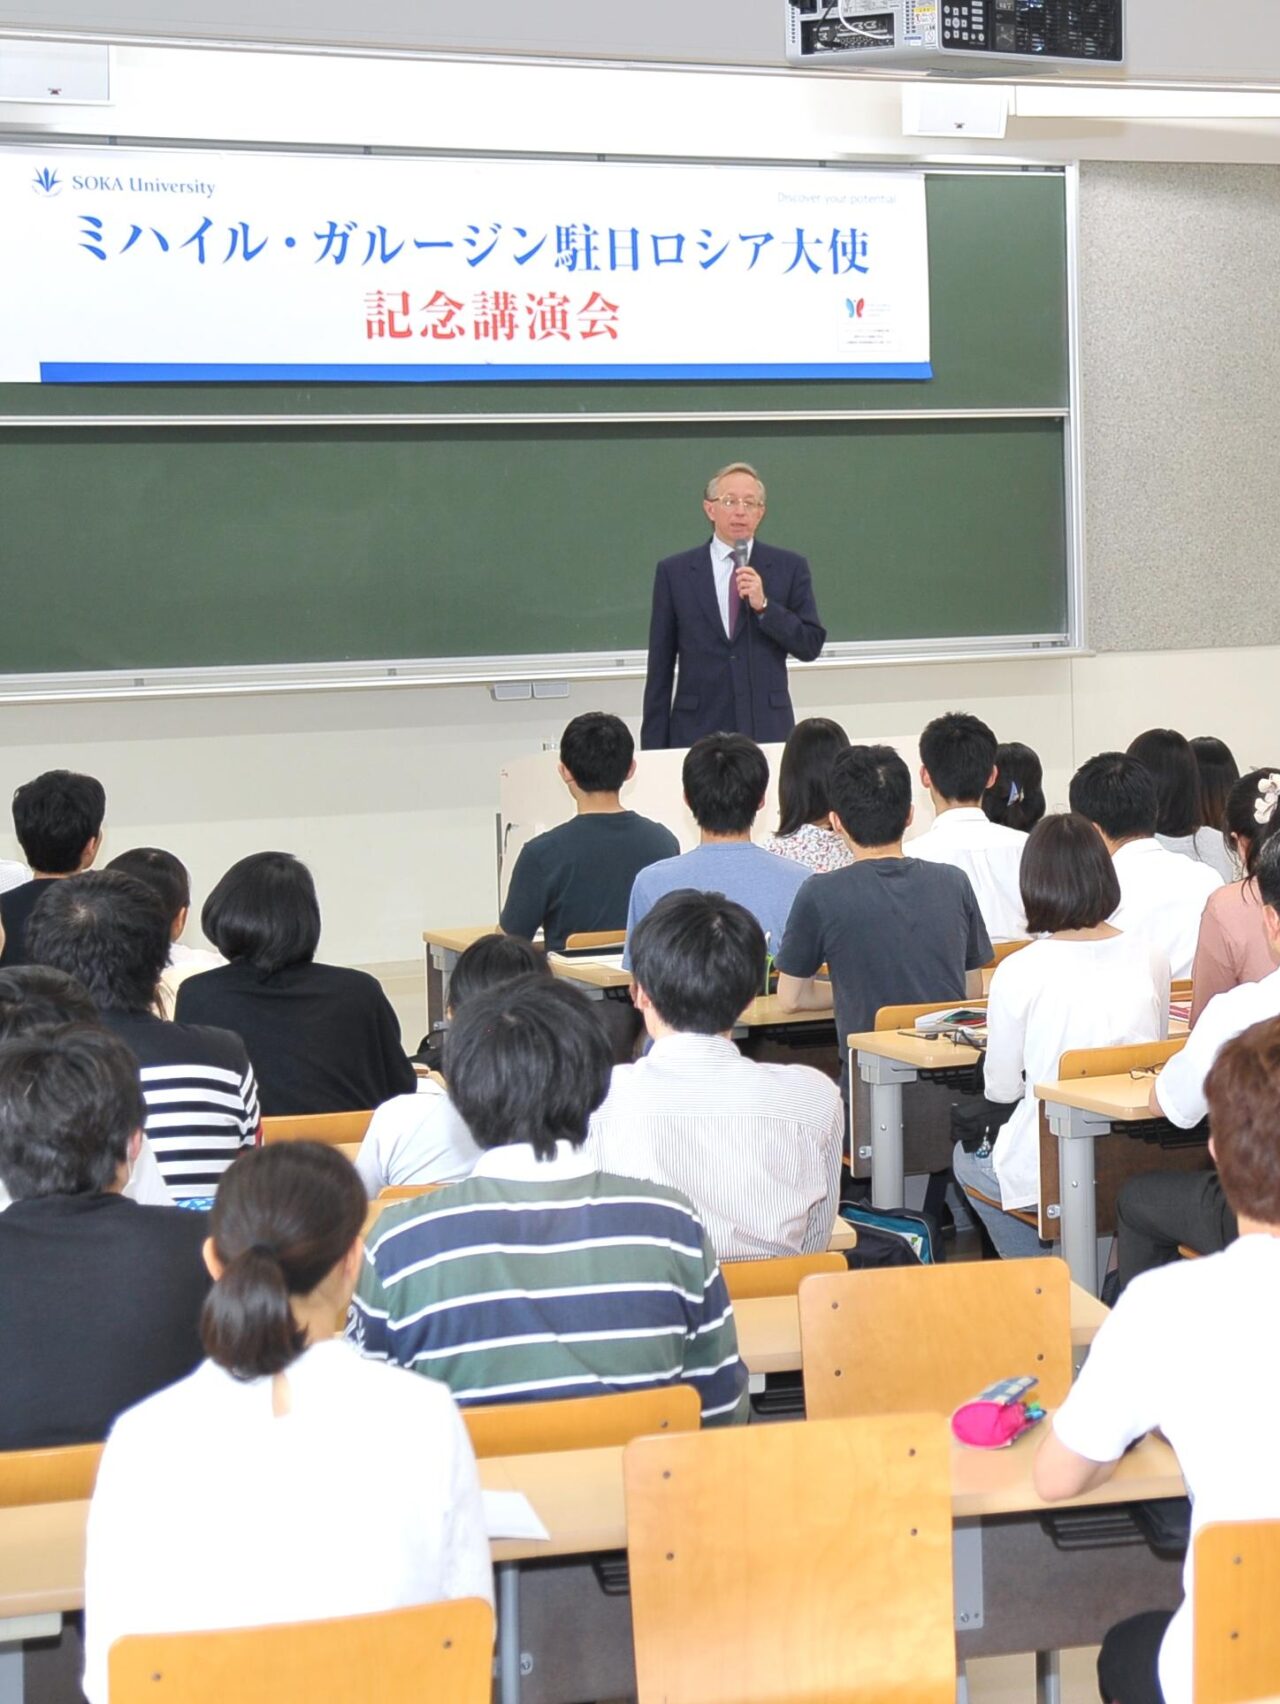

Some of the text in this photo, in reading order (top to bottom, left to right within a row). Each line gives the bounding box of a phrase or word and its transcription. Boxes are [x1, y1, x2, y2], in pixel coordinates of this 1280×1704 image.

[72, 175, 216, 199] SOKA University
[778, 191, 821, 204] Discover
[824, 194, 848, 207] your
[77, 214, 870, 275] ミハイル・ガルージン駐日ロシア大使
[365, 289, 620, 342] 記念講演会
